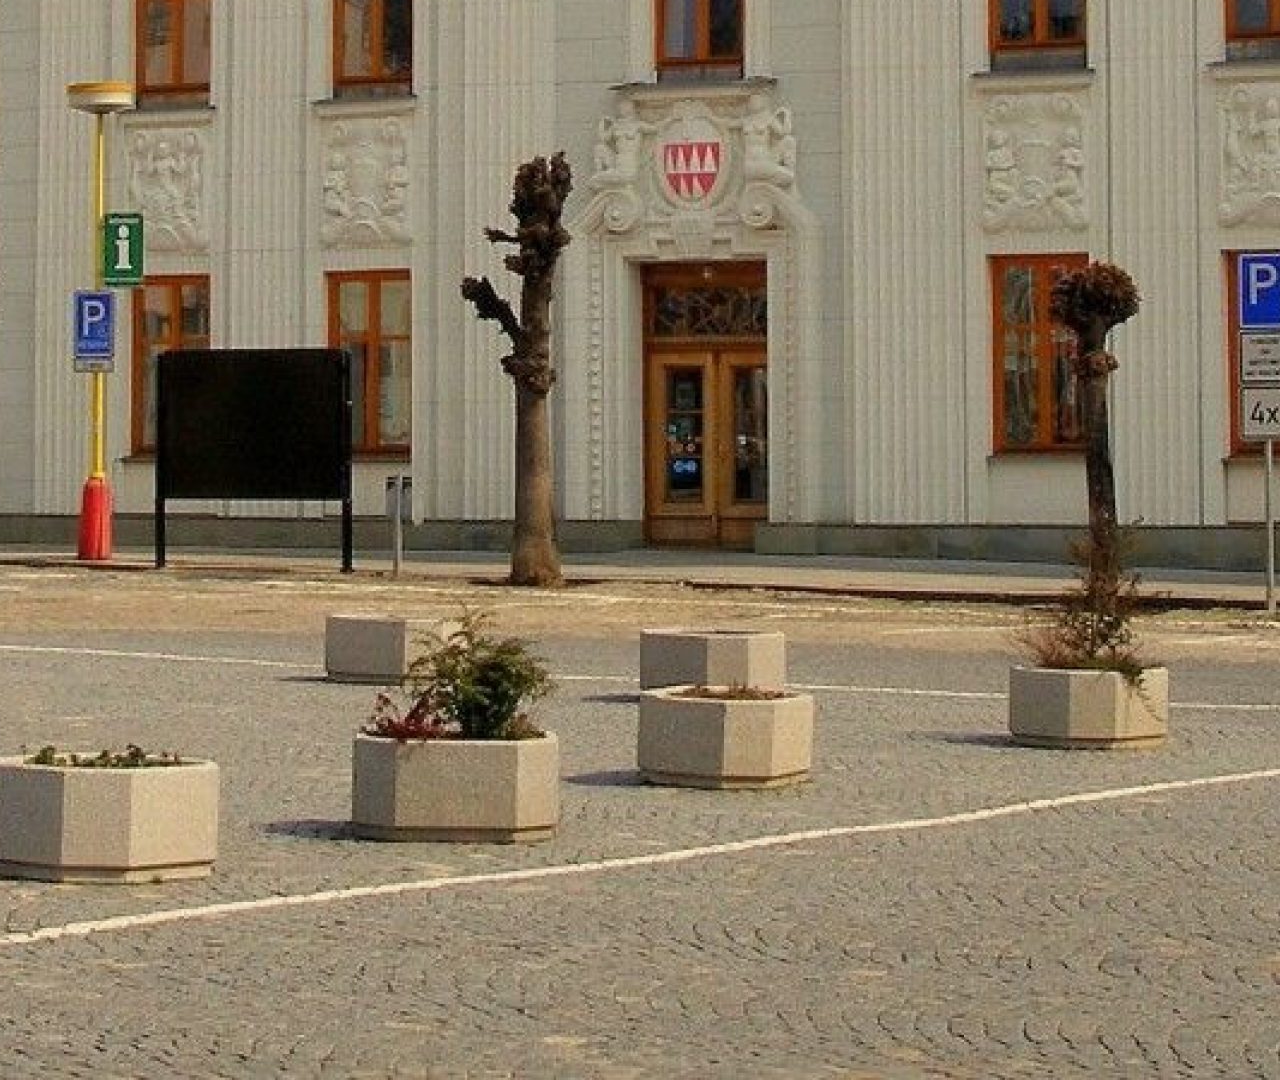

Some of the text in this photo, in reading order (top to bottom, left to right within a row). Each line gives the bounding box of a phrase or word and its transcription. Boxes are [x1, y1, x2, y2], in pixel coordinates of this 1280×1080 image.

[1249, 263, 1278, 305] P
[82, 300, 106, 337] P
[1251, 400, 1280, 425] 4x
